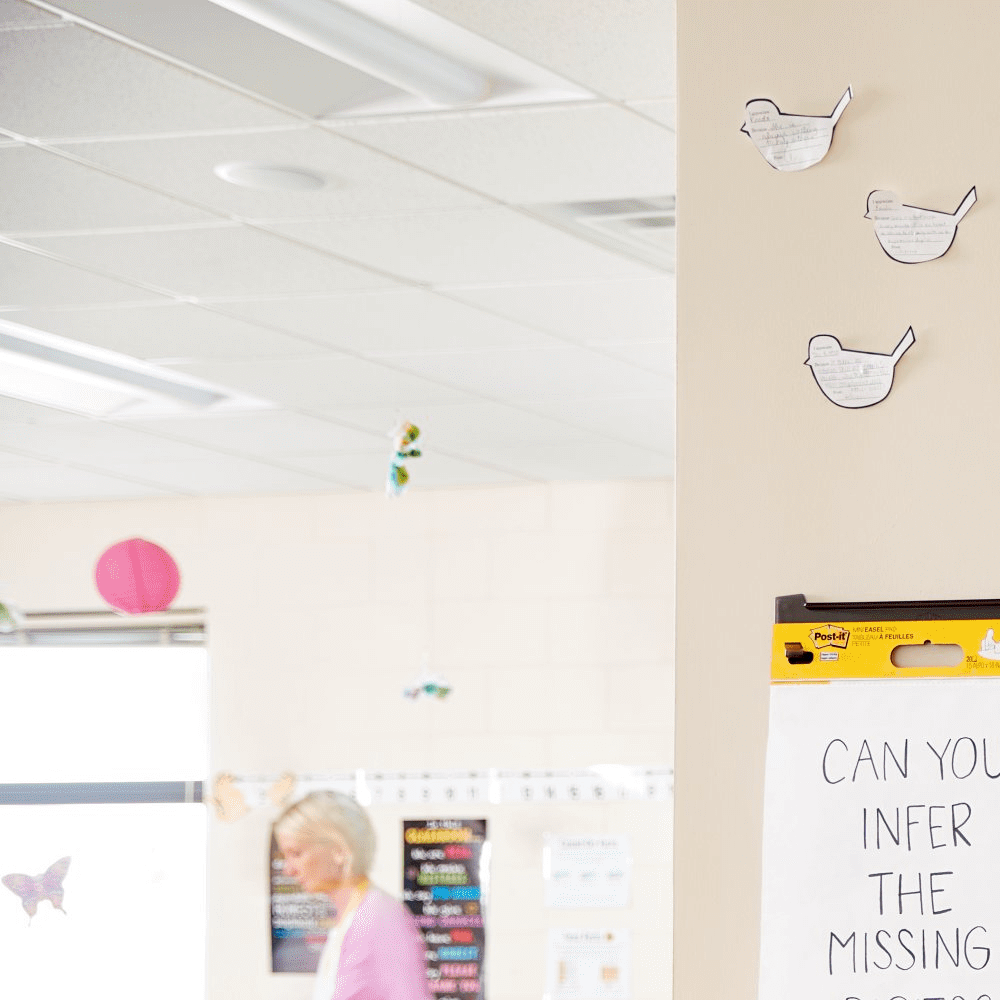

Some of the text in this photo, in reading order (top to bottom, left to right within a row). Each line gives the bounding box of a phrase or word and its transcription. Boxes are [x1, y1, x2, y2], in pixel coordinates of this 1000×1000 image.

[814, 632, 846, 641] Post-it
[822, 738, 908, 785] CAN
[863, 802, 972, 851] INFER
[868, 871, 953, 915] THE
[829, 925, 991, 975] MISSING
